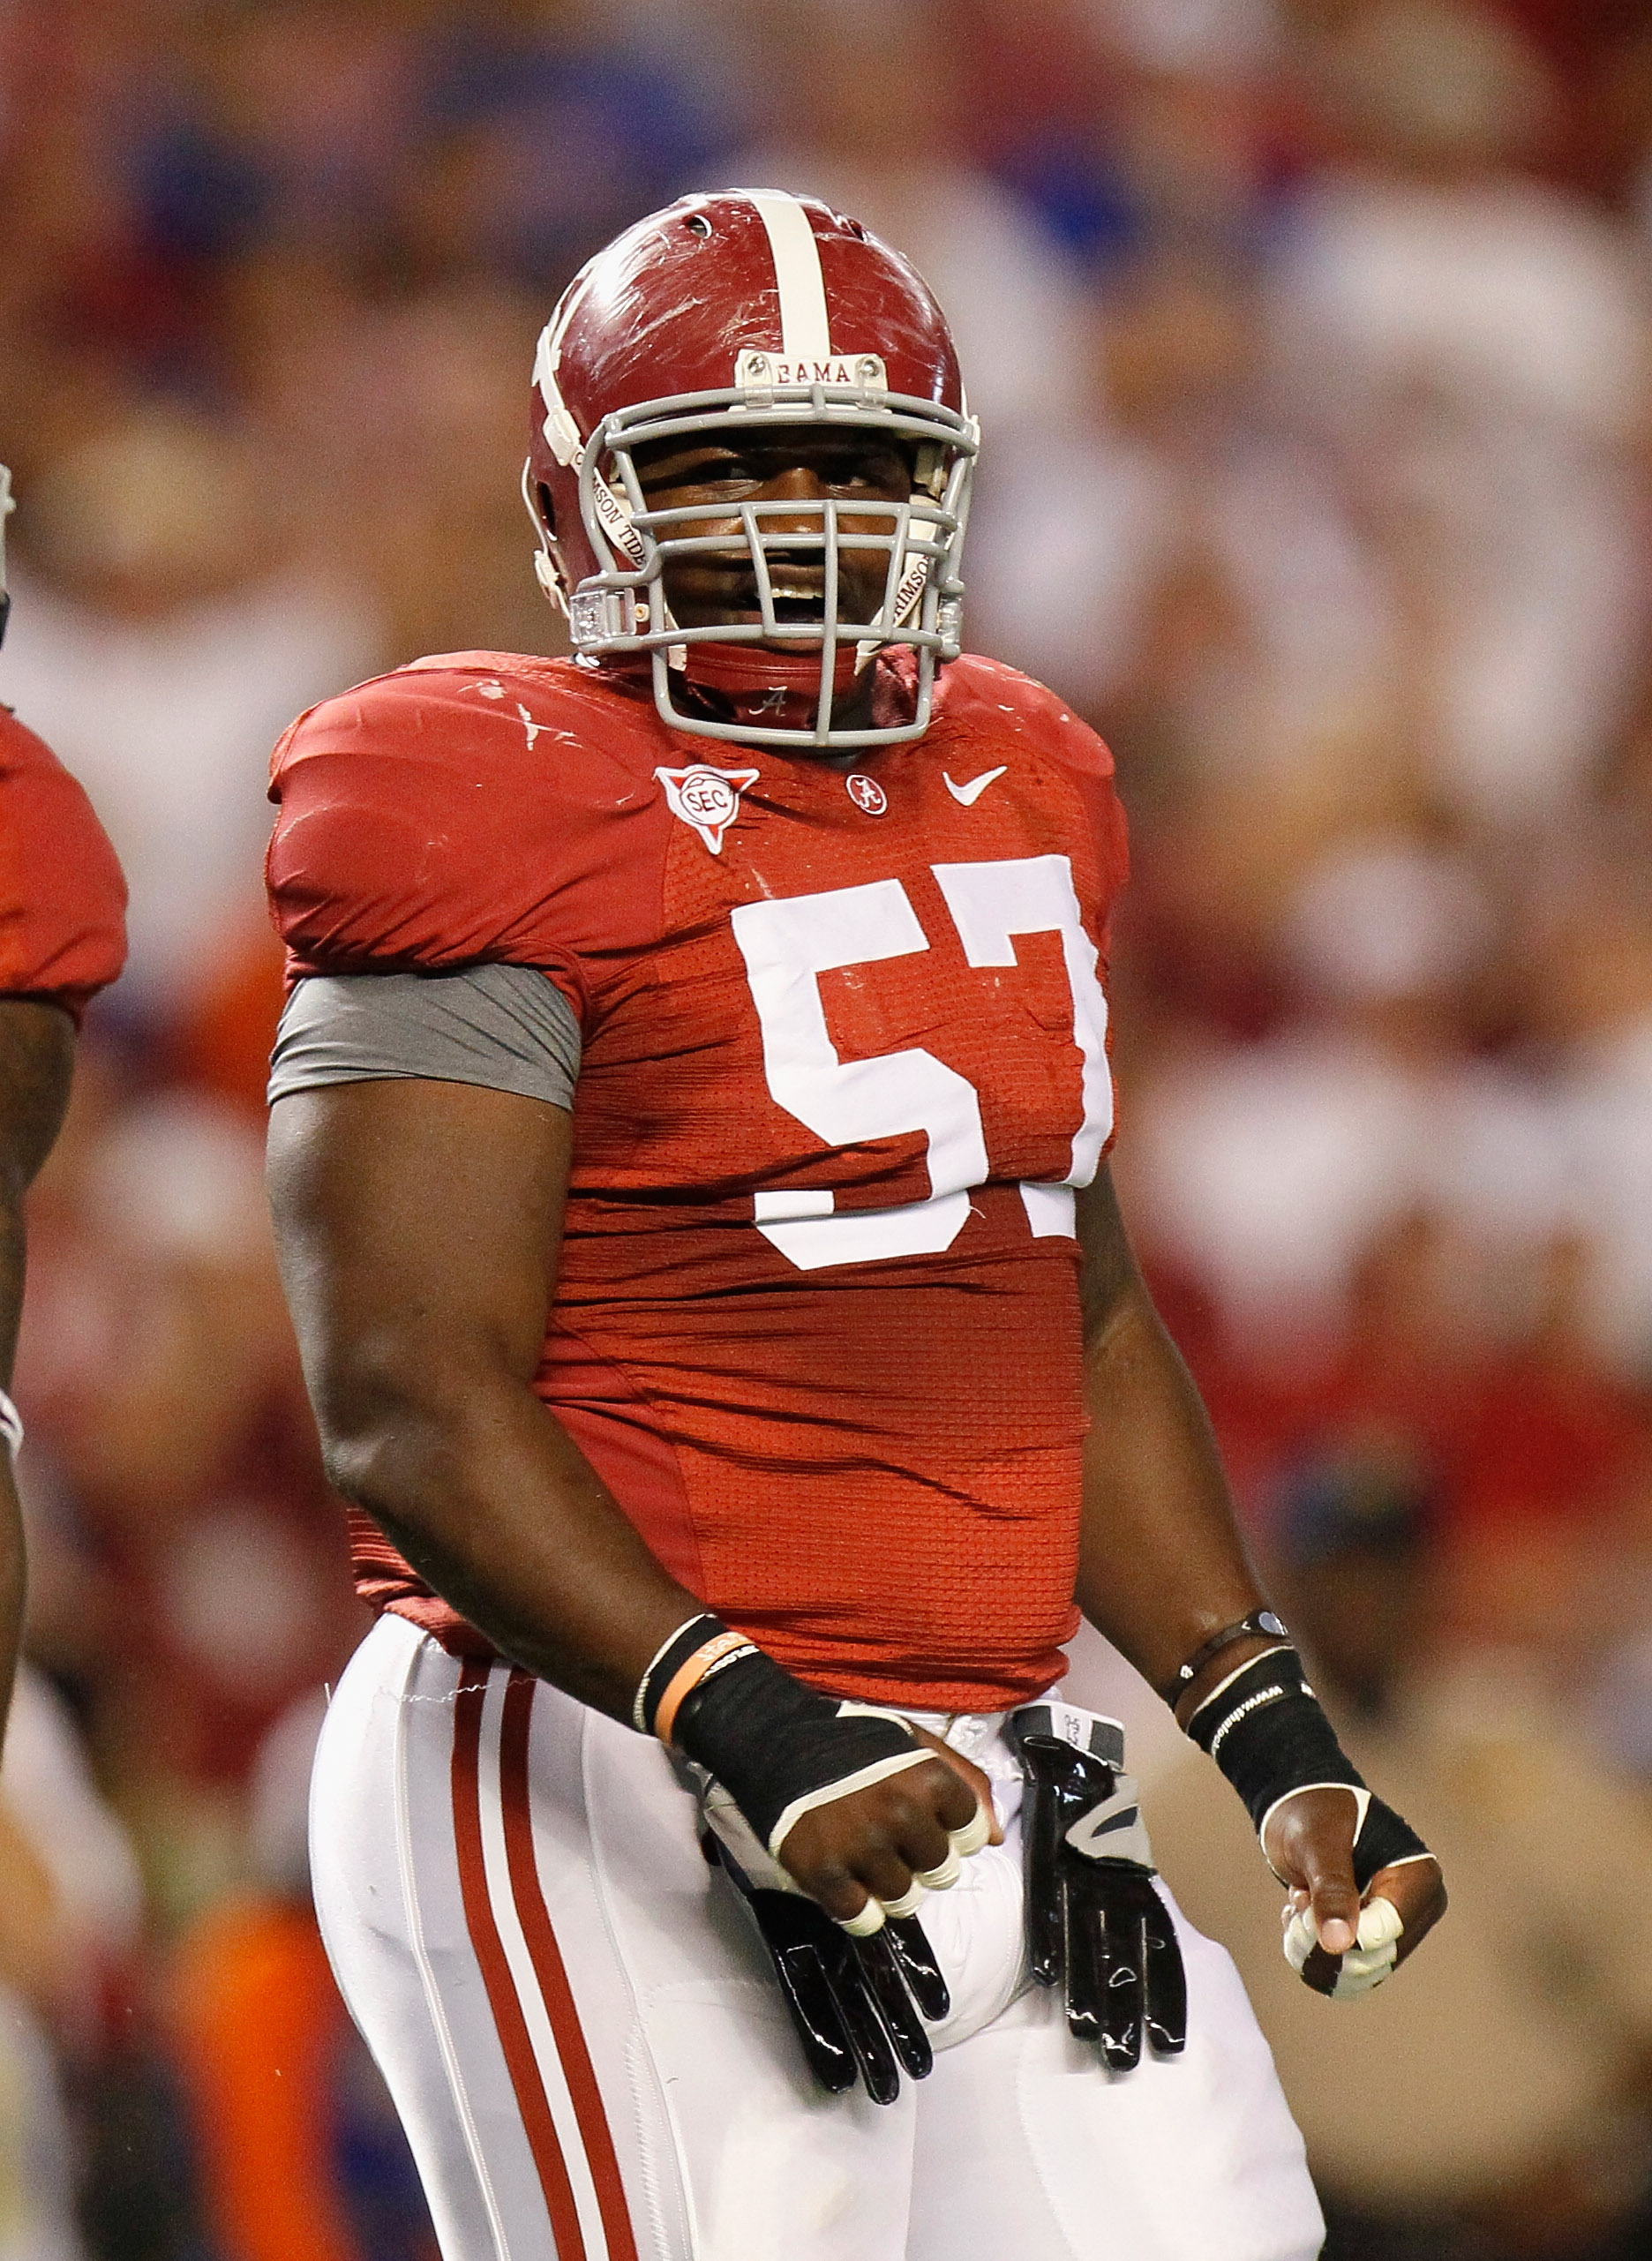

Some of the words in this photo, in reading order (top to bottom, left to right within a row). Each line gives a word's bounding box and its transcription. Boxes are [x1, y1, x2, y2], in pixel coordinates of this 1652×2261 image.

[777, 362, 851, 383] BAMA
[687, 790, 728, 812] SEC
[731, 853, 1115, 1271] 57
